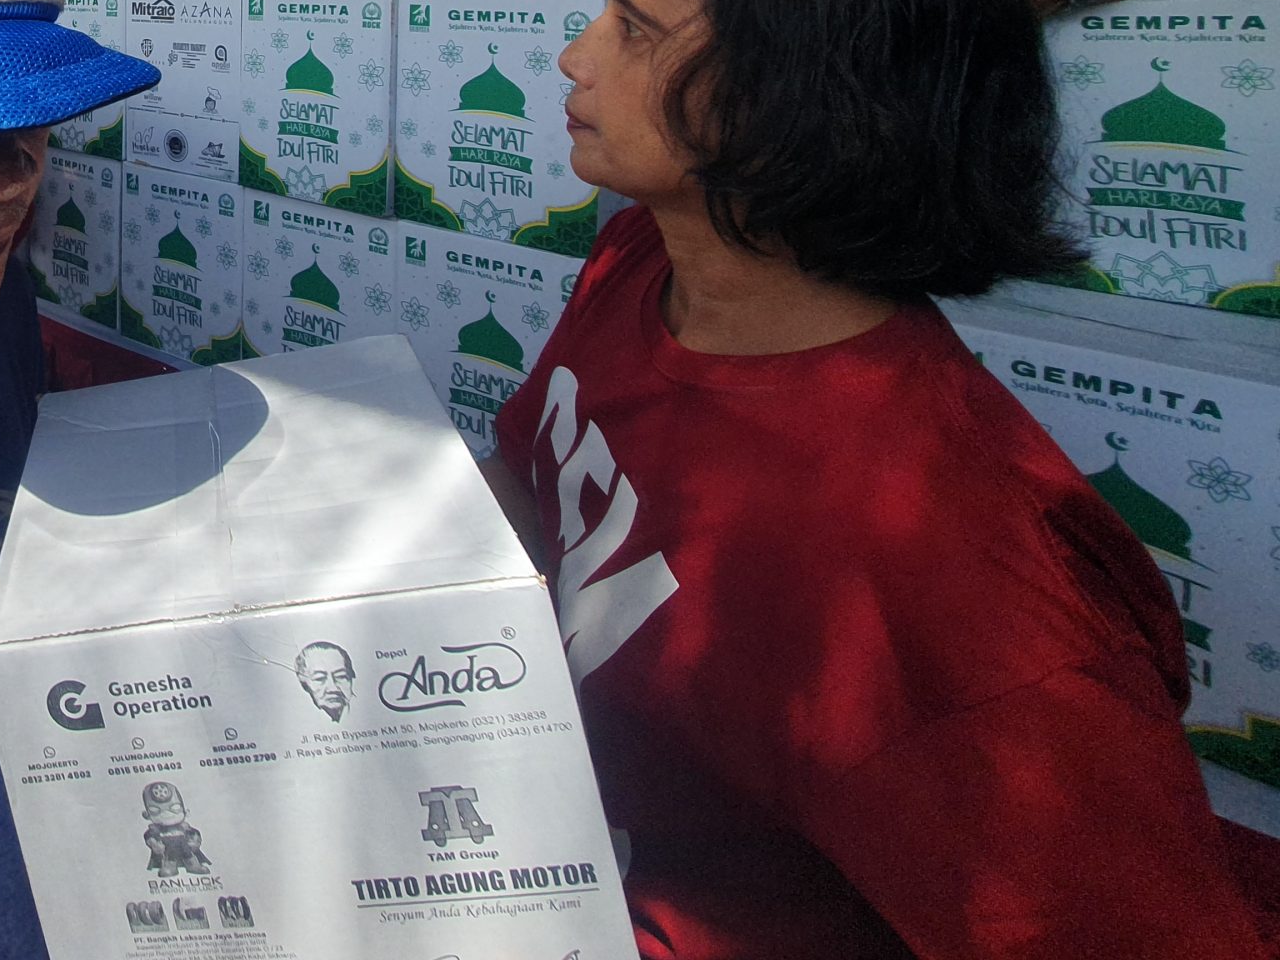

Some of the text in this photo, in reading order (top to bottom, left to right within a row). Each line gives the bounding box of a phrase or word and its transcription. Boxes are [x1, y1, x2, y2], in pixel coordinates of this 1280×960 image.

[181, 1, 233, 19] AZANA
[278, 3, 349, 16] GEMPITA
[448, 9, 546, 25] GEMPITA
[1081, 15, 1267, 30] GEMPITA
[280, 98, 340, 126] SELAMAT
[286, 123, 331, 139] HARI RAYA
[451, 120, 533, 152] SELAMAT
[51, 156, 94, 174] GEMPITA
[307, 142, 338, 165] FITRI
[460, 148, 521, 168] HARI RAYA
[488, 171, 532, 199] FITRI
[1089, 154, 1244, 194] SELAMAT
[151, 183, 209, 203] GEMPITA
[1108, 191, 1222, 213] HARI RAYA
[282, 210, 355, 236] GEMPITA
[1161, 216, 1247, 252] FITRI
[446, 250, 544, 283] GEMPITA
[153, 265, 202, 294] SELAMAT
[176, 305, 202, 329] FITRI
[284, 305, 346, 342] SELAMAT
[1011, 359, 1223, 420] GEMPITA
[1011, 378, 1070, 400] Sejahtera
[1116, 402, 1183, 426] Sejahtera
[376, 648, 408, 660] Depot
[108, 642, 526, 712] Ganesha Anda
[113, 692, 212, 719] Operation
[314, 732, 340, 744] Raya
[342, 728, 378, 741] Bypass
[381, 725, 398, 736] KM
[419, 719, 469, 733] Mojokerto
[297, 748, 323, 759] Raya
[325, 742, 372, 755] Surabaya
[28, 759, 79, 771] MOJOKERTO
[427, 848, 499, 863] TAM Group
[351, 863, 598, 901] TIRTO AGUNG MOTOR
